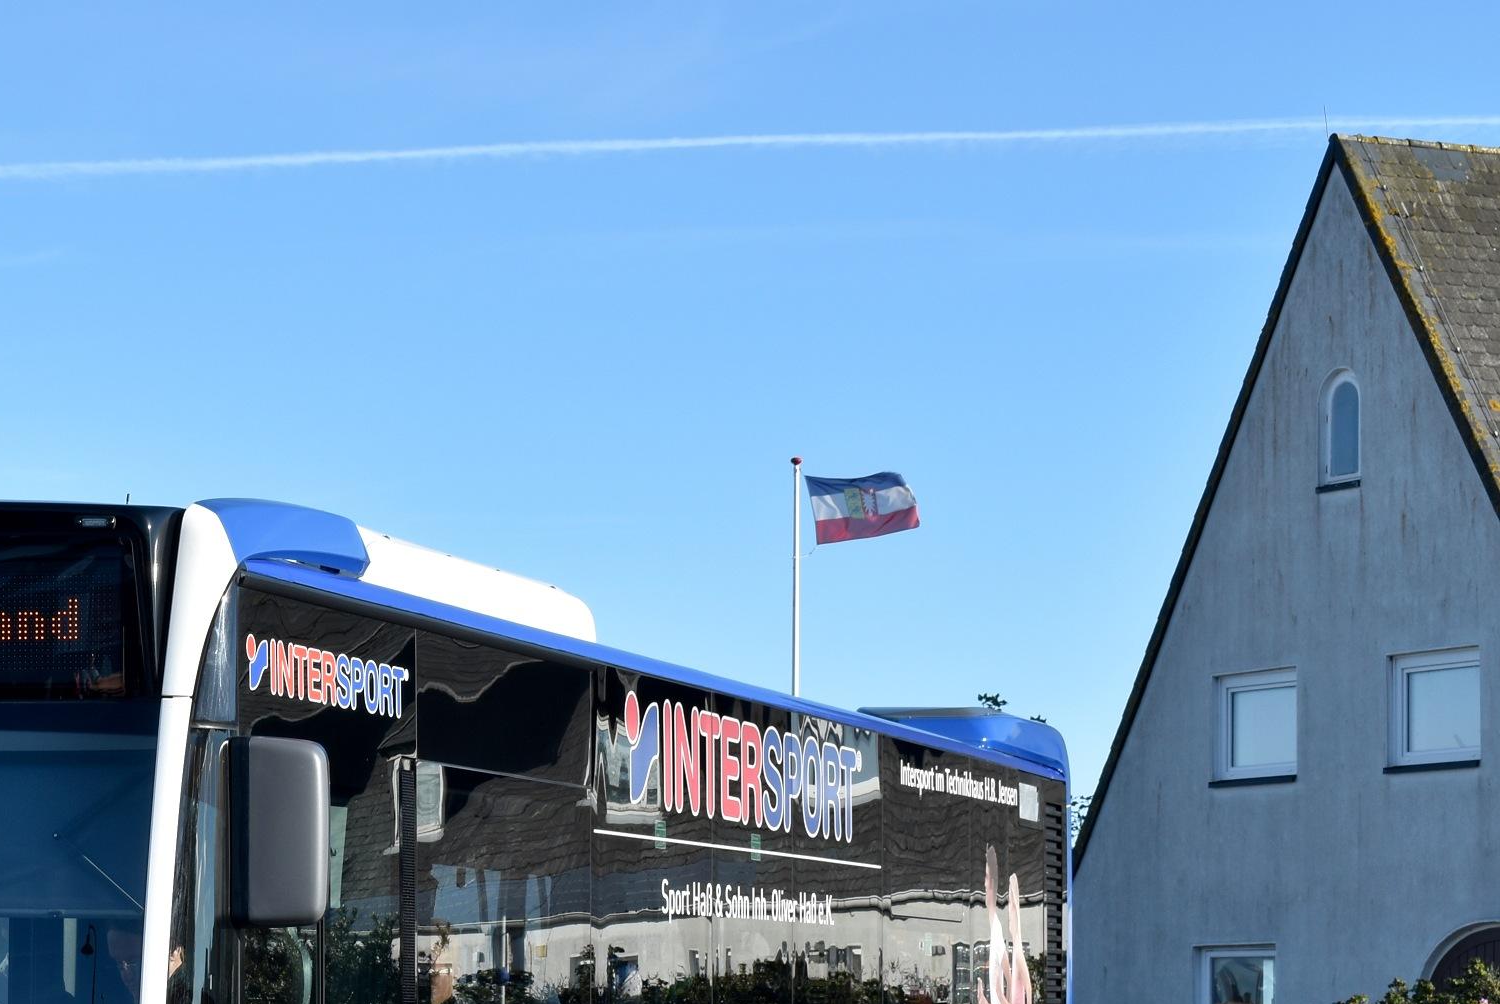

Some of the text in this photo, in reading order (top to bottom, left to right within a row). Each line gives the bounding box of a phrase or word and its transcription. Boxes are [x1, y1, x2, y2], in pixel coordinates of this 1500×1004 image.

[270, 638, 405, 719] INTERSPORT
[662, 699, 856, 843] INTERSPORT
[900, 759, 1018, 806] Intersport im Technikhaus H.B. Jensen
[661, 878, 690, 924] Sport
[692, 881, 712, 917] Haß
[715, 883, 723, 918] &
[725, 884, 750, 919] Sohn
[751, 887, 770, 920] Inh.
[771, 888, 798, 922] Oliver
[799, 891, 817, 924] Haß
